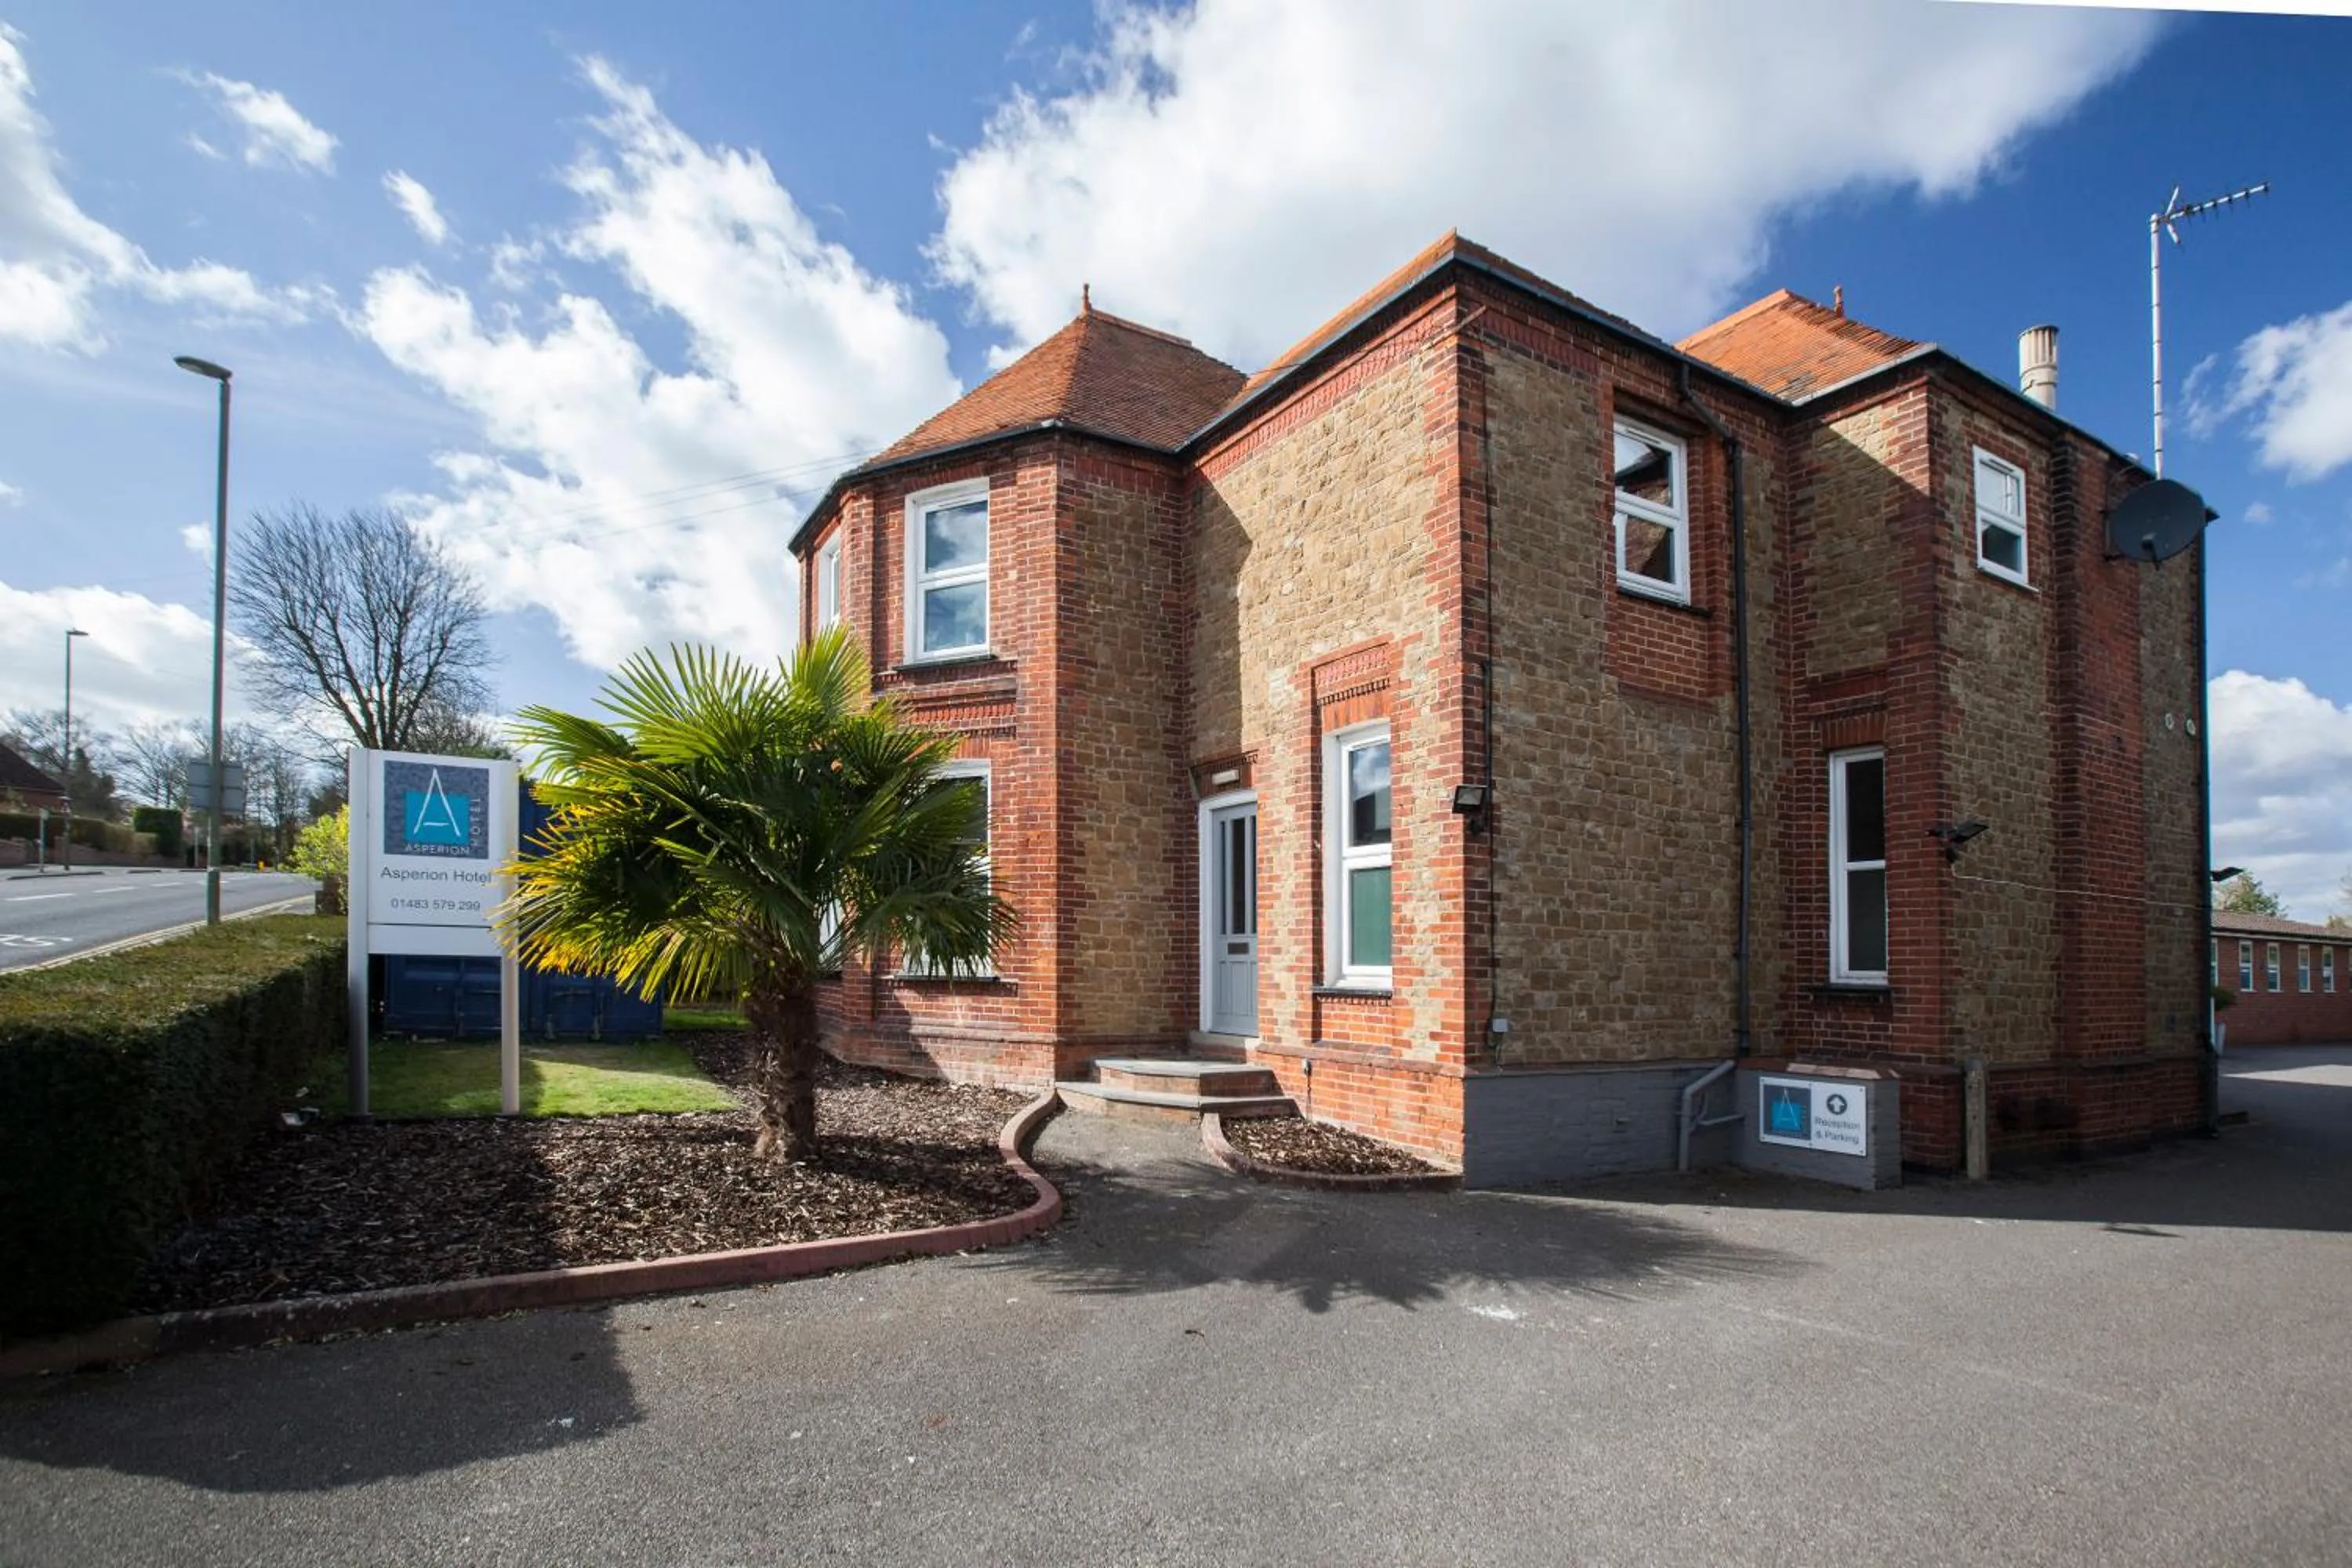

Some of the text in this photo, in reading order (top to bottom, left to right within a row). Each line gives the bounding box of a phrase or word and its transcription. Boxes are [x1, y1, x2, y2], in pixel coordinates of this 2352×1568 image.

[413, 768, 462, 837] A
[405, 843, 470, 856] ASPERION
[380, 866, 492, 884] Asperion Hotel
[391, 898, 481, 912] 01483 579 299
[1824, 1131, 1860, 1145] Parking
